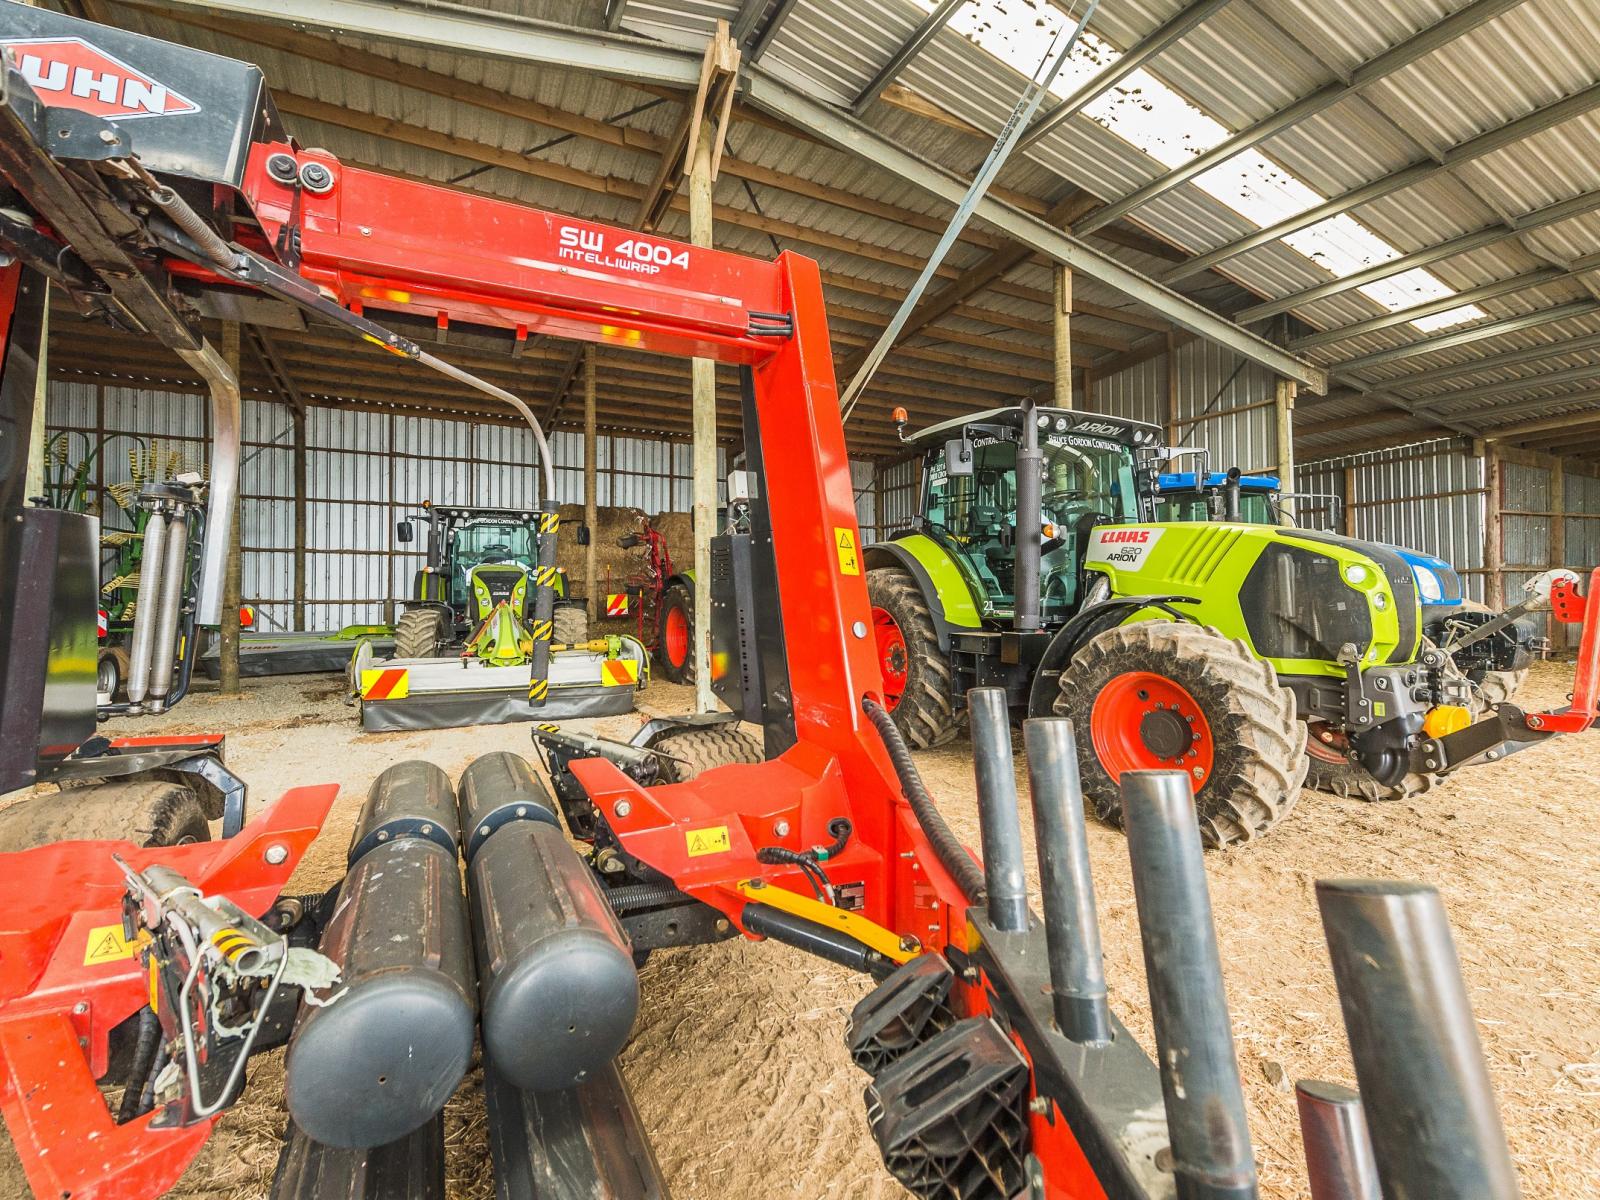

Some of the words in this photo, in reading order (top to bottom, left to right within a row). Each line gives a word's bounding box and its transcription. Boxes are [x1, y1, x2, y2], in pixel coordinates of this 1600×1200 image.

[21, 54, 167, 115] UHN
[559, 226, 604, 252] SW
[615, 239, 690, 270] 4004
[559, 247, 660, 275] INTELLIWRAP
[1048, 434, 1069, 445] BRUCE
[1068, 435, 1093, 448] GORDON
[1092, 438, 1123, 453] CONTRACTING
[1100, 531, 1150, 544] CLAAS
[1106, 553, 1138, 562] ARION
[1120, 546, 1143, 555] 620
[983, 600, 995, 611] 21
